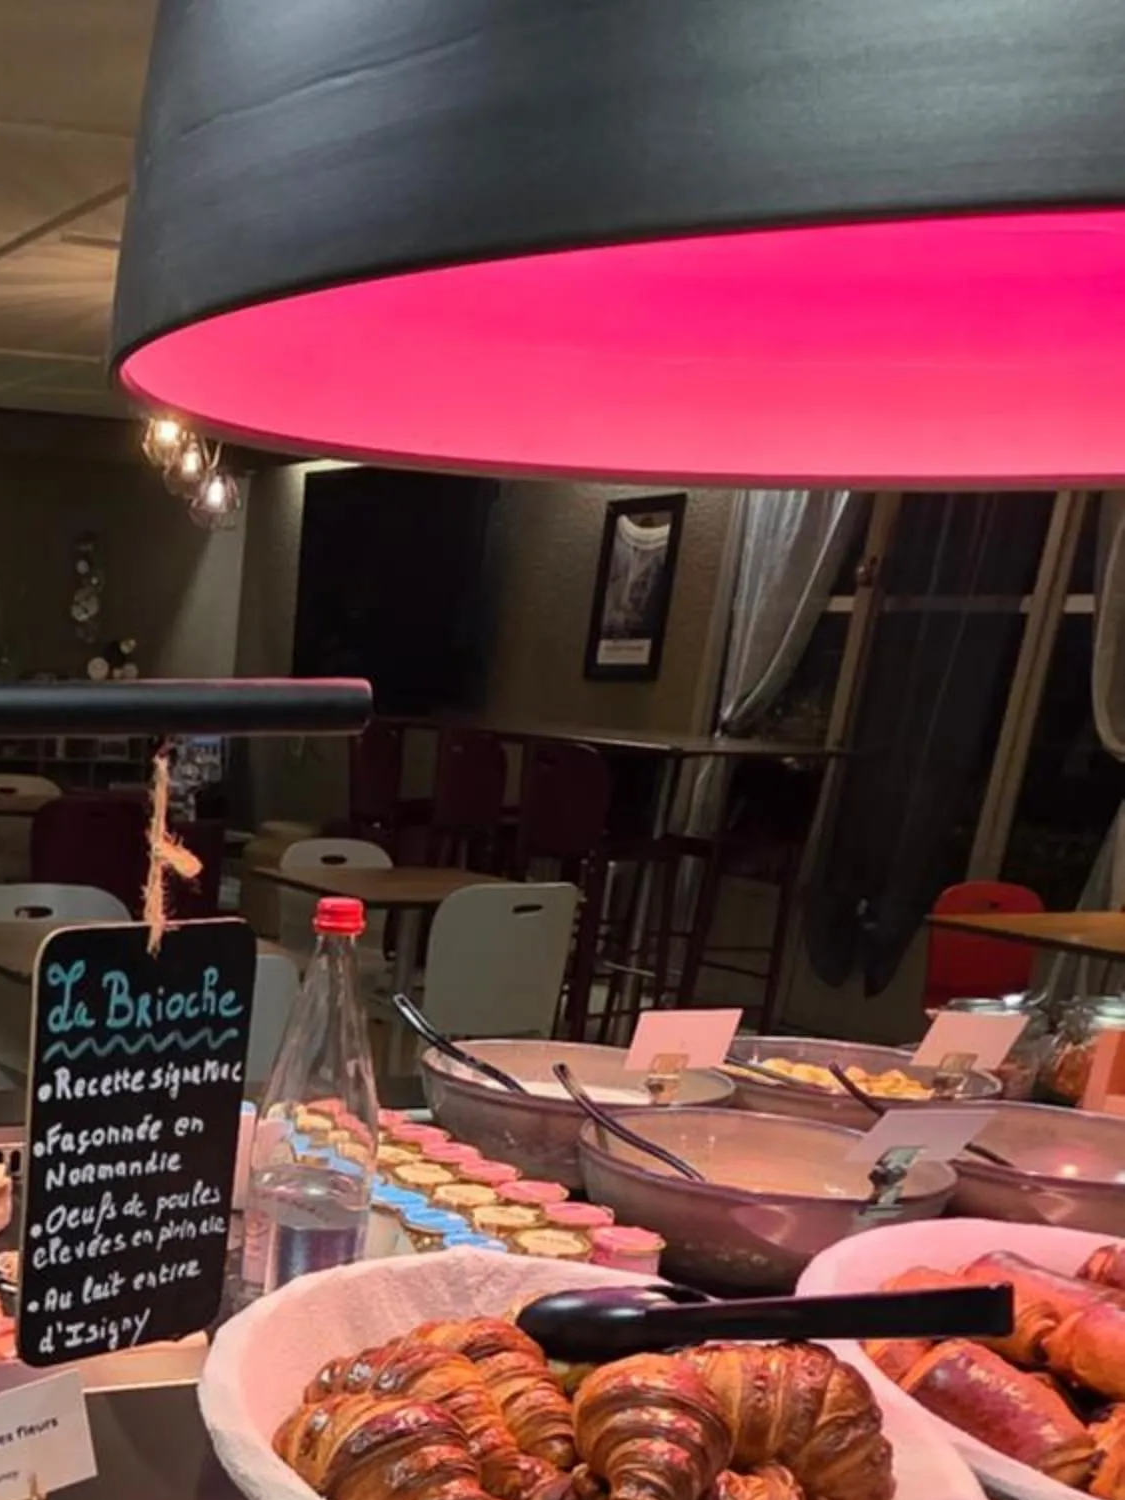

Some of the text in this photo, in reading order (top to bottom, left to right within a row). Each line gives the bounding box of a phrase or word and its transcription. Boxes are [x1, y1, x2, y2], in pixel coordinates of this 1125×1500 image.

[54, 1066, 145, 1100] Recette
[174, 1116, 205, 1136] en
[122, 1193, 147, 1217] de
[154, 1179, 221, 1221] poules
[132, 1229, 153, 1247] en
[82, 1272, 125, 1305] lait
[16, 1417, 58, 1439] fleurs
